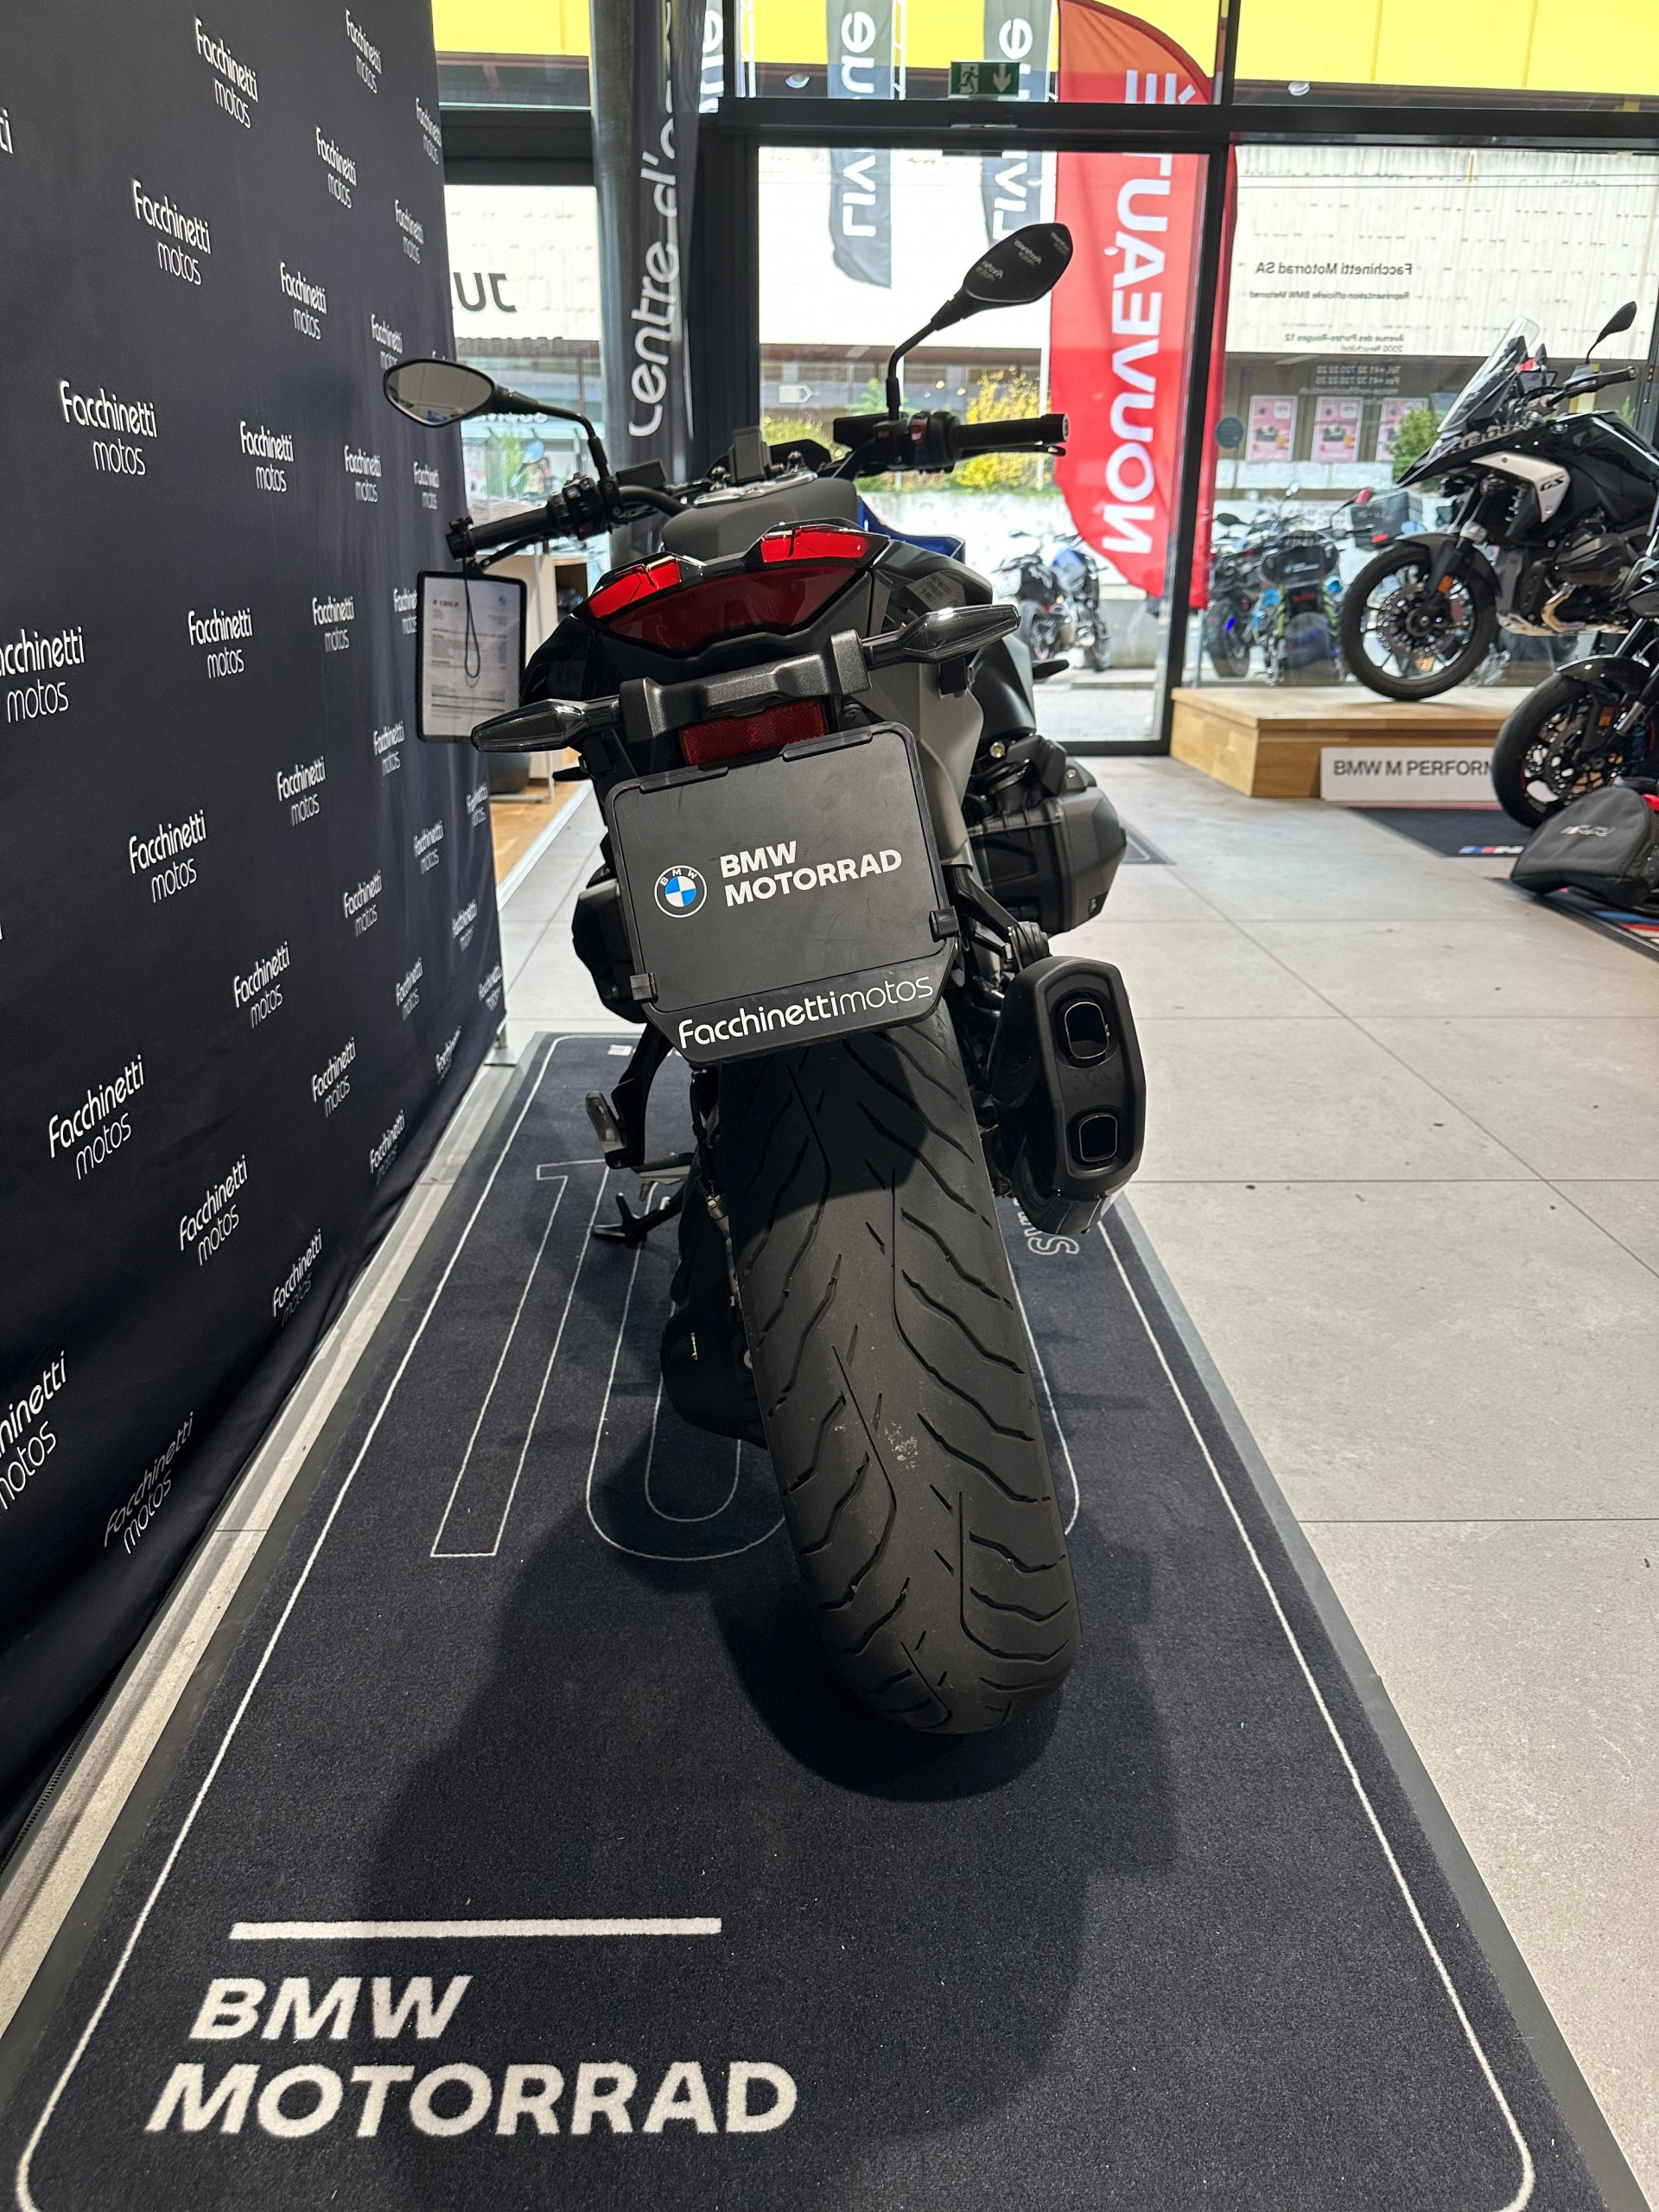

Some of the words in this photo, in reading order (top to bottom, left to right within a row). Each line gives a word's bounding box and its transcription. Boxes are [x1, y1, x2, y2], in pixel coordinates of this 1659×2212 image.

[195, 16, 258, 102] Facchinetti
[346, 10, 382, 74] Facchinetti
[355, 53, 378, 94] motos
[214, 78, 251, 129] motos
[315, 125, 357, 187] Facchinetti
[327, 172, 352, 209] motos
[131, 179, 211, 254] Facchinetti
[394, 199, 424, 245] Facchinetti
[156, 240, 201, 286] motos
[402, 232, 420, 264] motos
[280, 261, 327, 314] Facchinetti
[293, 306, 321, 340] motos
[60, 379, 156, 437] Facchinetti
[92, 438, 146, 476] motos
[240, 420, 293, 462] Facchinetti
[344, 445, 382, 478] Facchinetti
[256, 462, 287, 493] motos
[354, 478, 378, 503] motos
[188, 607, 252, 645] Facchinetti
[312, 595, 354, 626] Facchinetti
[0, 626, 85, 675] acchinetti
[207, 647, 245, 679] motos
[324, 627, 349, 652] motos
[6, 679, 69, 723] motos
[276, 755, 326, 802] Facchinetti
[1333, 760, 1382, 776] BMW
[1385, 760, 1403, 776] M
[291, 793, 320, 827] motos
[129, 809, 207, 874] Facchinetti
[720, 841, 797, 878] BMW
[150, 857, 198, 904] motos
[344, 869, 383, 918] Facchinetti
[724, 849, 902, 907] MOTORRAD
[354, 904, 378, 938] motos
[232, 941, 290, 1009] Facchinetti
[250, 983, 283, 1029] motos
[311, 1036, 356, 1103] Facchinetti
[48, 1054, 144, 1159] Facchinetti
[324, 1074, 351, 1118] motos
[75, 1113, 131, 1180] motos
[369, 1109, 405, 1173] Facchinetti
[179, 1154, 249, 1251] Facchinetti
[198, 1205, 239, 1266] motos
[272, 1228, 323, 1318] Facchinetti
[104, 1410, 194, 1548] Facchinetti
[124, 1473, 172, 1554] motos
[188, 1975, 474, 2041] BMW
[146, 2060, 798, 2138] MOTORRAD
